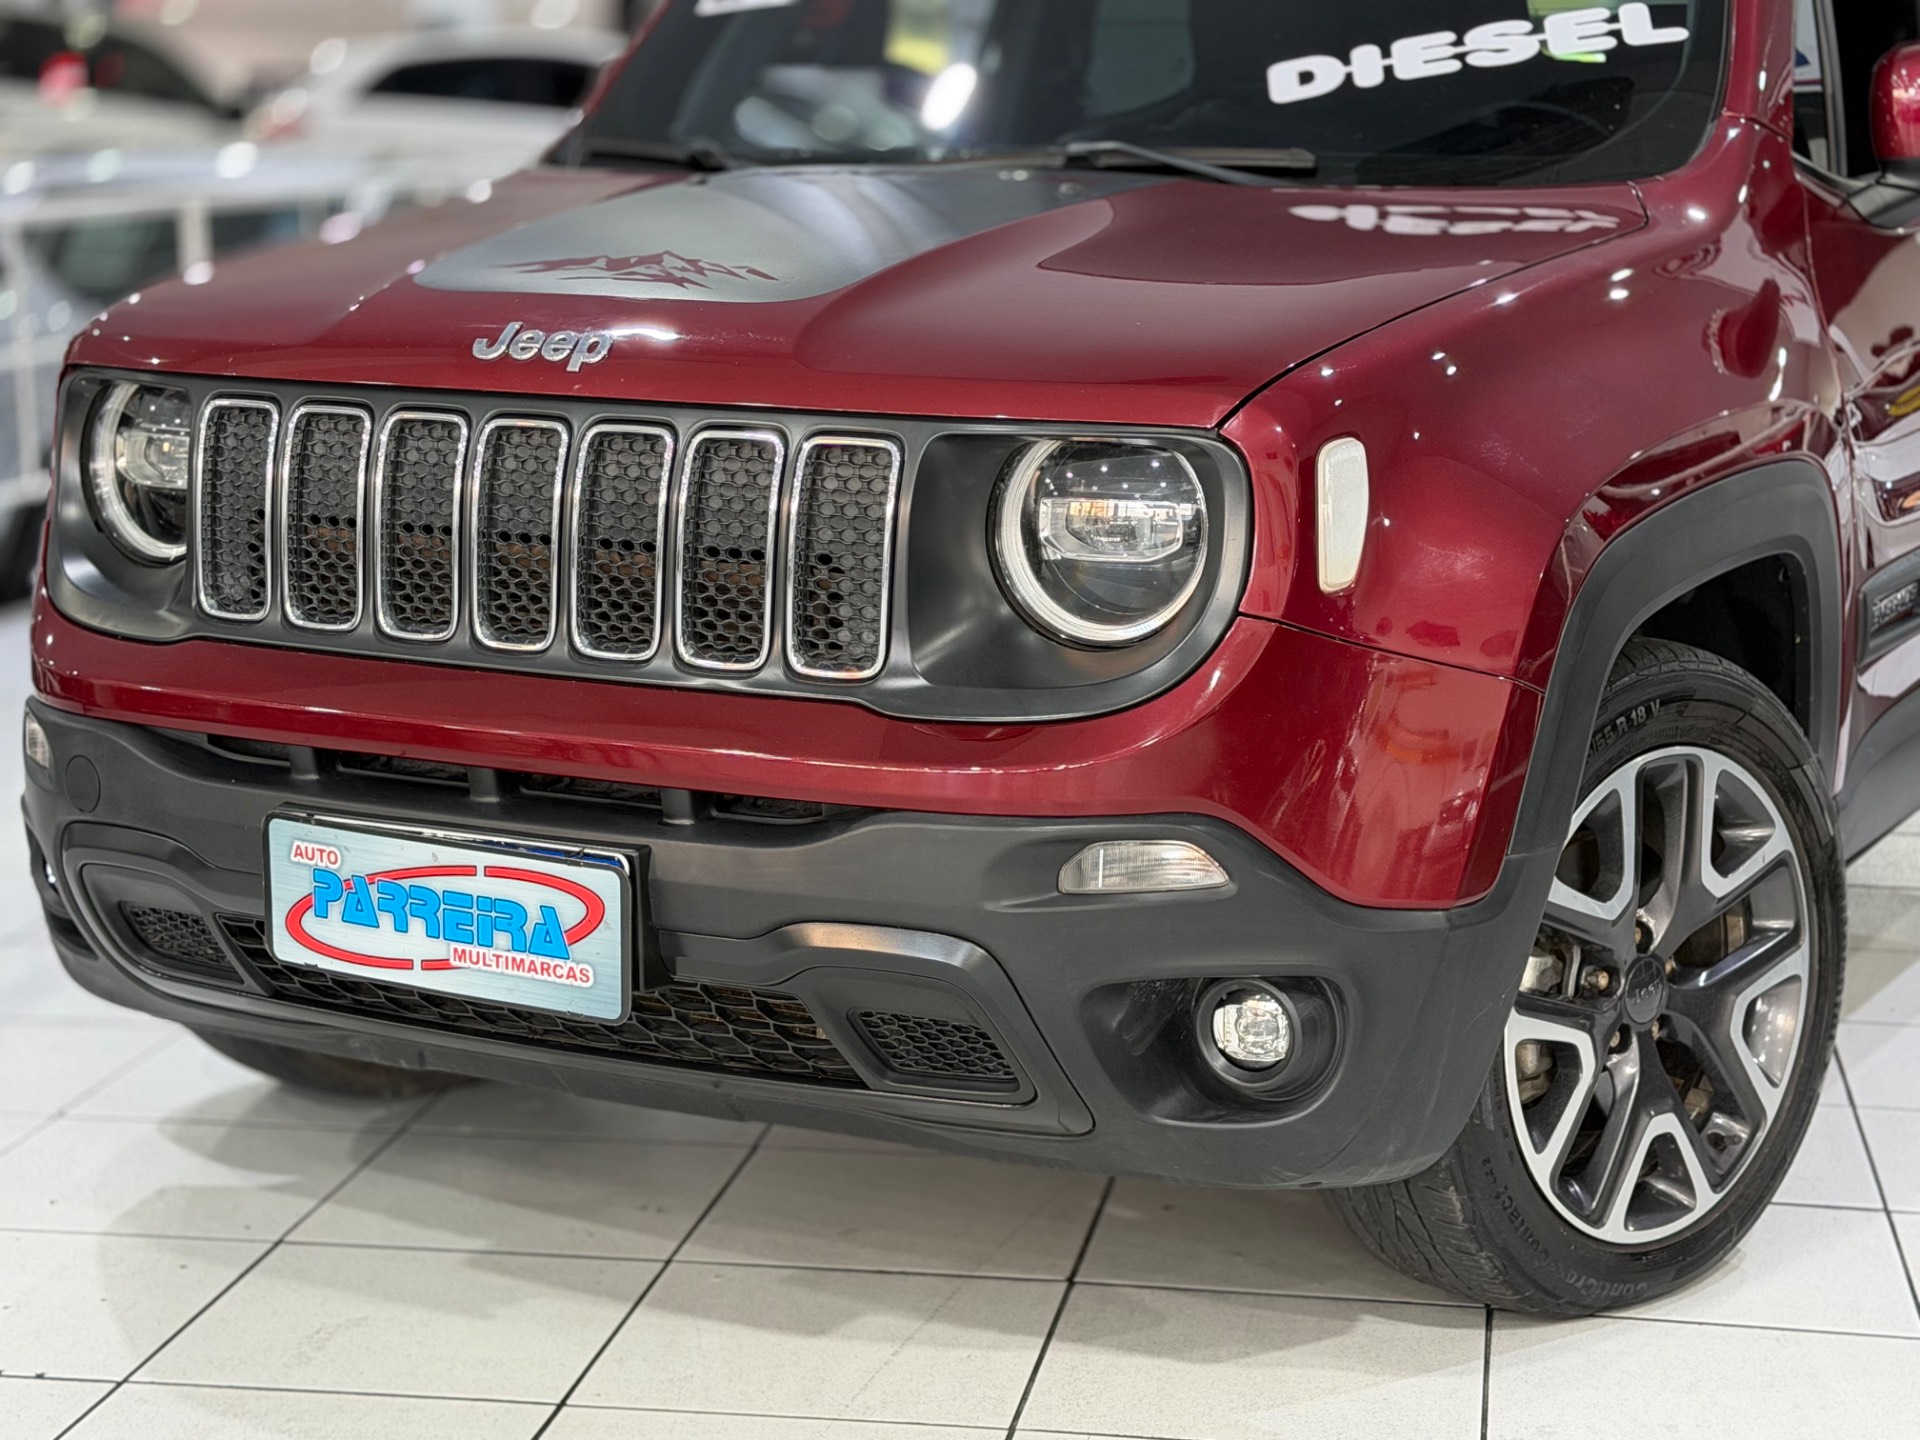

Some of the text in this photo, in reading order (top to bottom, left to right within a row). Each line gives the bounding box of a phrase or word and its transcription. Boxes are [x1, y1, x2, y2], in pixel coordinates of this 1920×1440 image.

[1267, 2, 1689, 104] DIESEL
[472, 321, 614, 372] Jeep
[1631, 706, 1646, 726] 18
[293, 843, 339, 866] AUTO
[312, 868, 571, 961] PARREIRA
[452, 946, 591, 984] MULTIMARCAS
